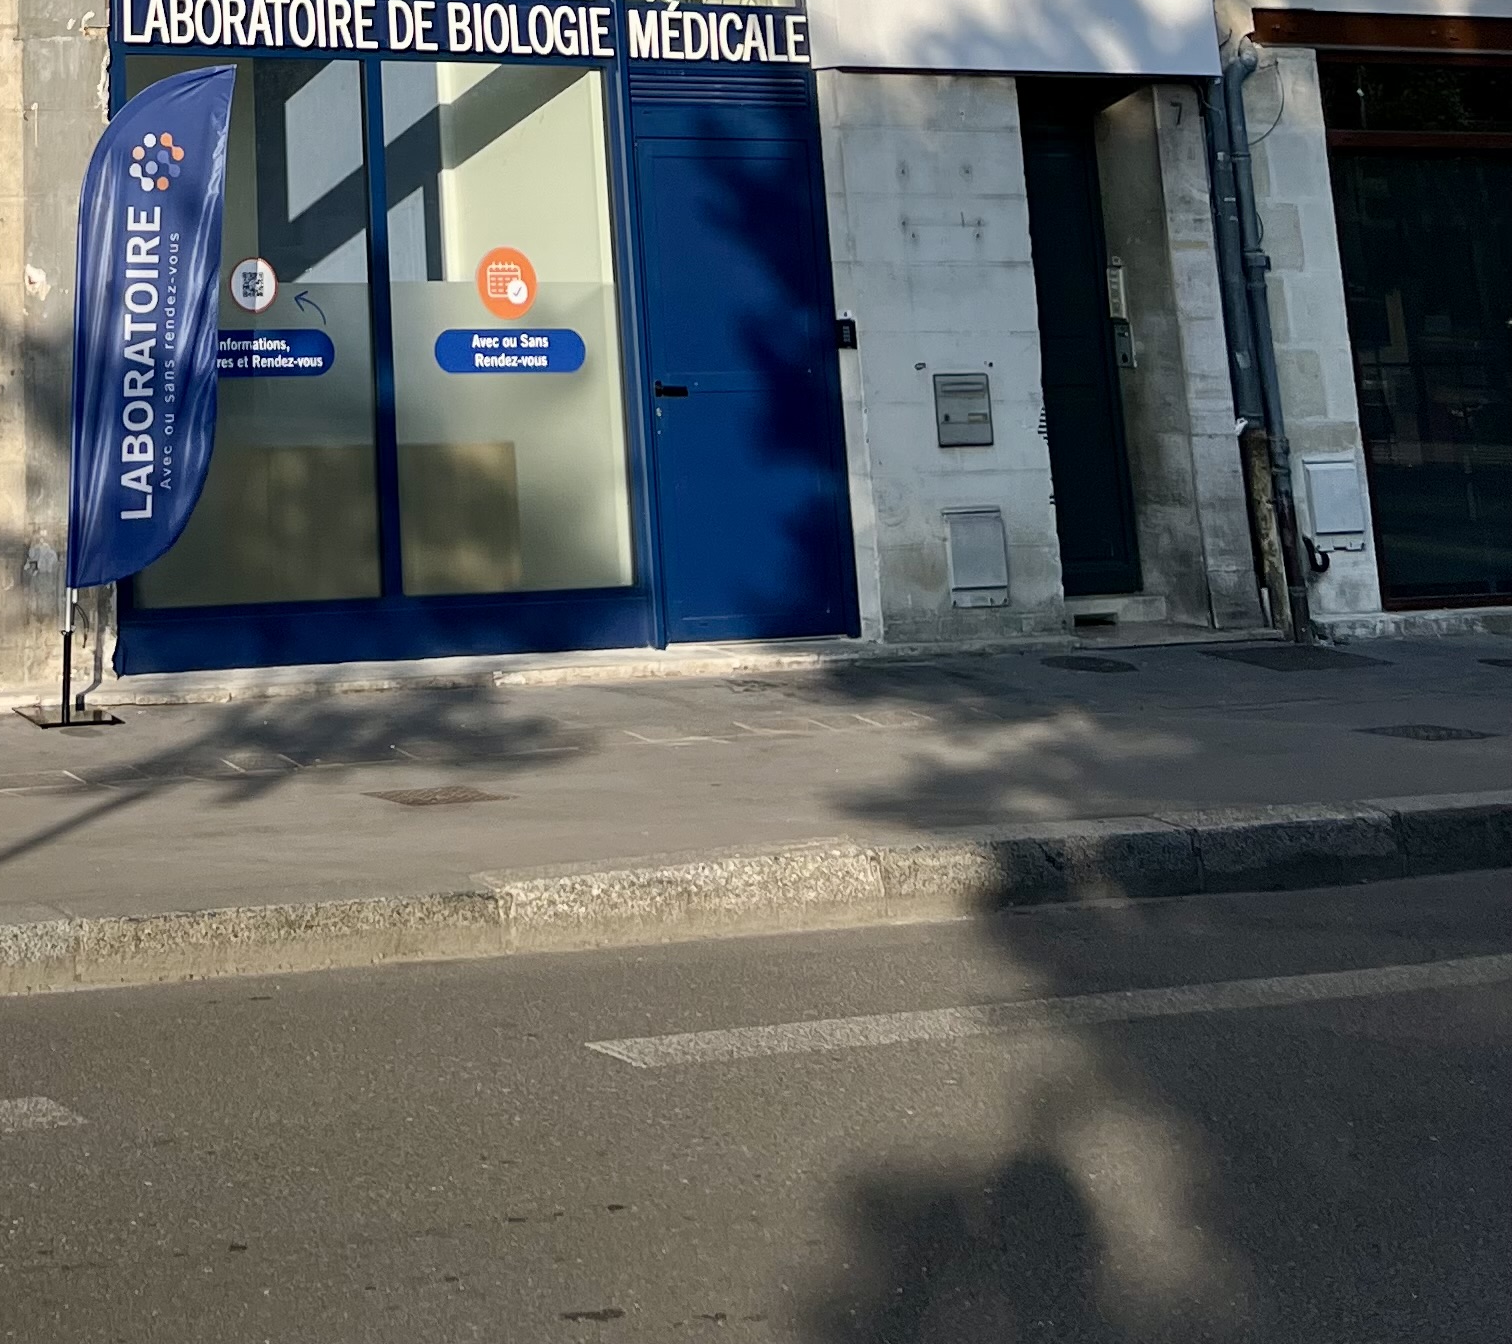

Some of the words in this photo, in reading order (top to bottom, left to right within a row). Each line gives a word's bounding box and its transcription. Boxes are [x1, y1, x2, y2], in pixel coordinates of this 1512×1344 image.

[447, 1, 615, 57] BIOLOGIE
[628, 0, 811, 63] MÉDICALE
[164, 232, 181, 350] rendez-vous
[219, 337, 290, 353] nformations,
[471, 333, 500, 349] Avec
[501, 336, 518, 348] ou
[519, 333, 549, 349] Sans
[120, 206, 162, 520] LABORATOIRE
[237, 356, 249, 369] et
[251, 354, 324, 369] Rendez-vous
[474, 352, 549, 368] Rendez-vous
[164, 359, 176, 403] sans
[164, 413, 175, 436] ou
[159, 445, 173, 490] Avec
